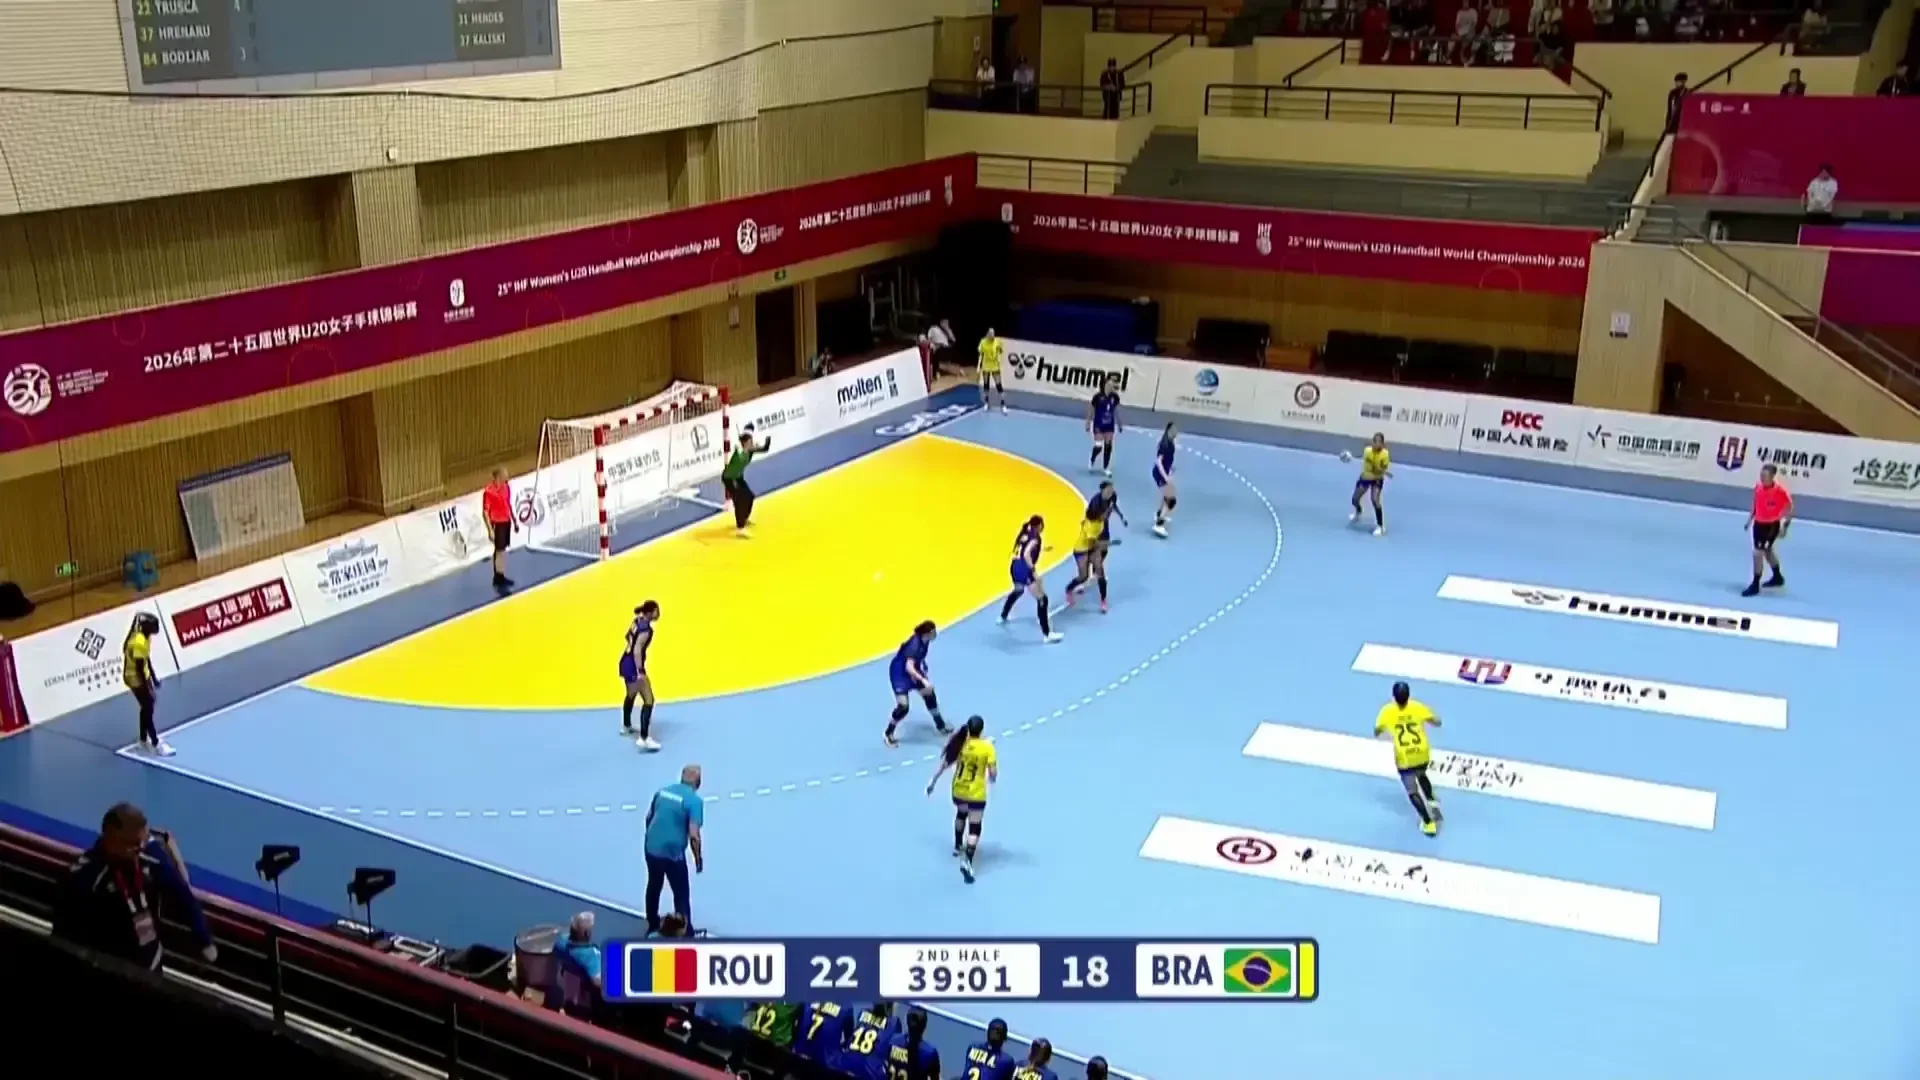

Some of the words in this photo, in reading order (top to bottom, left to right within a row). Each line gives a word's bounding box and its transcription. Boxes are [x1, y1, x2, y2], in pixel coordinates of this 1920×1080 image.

[530, 270, 569, 289] Women's
[570, 265, 587, 280] U20
[588, 259, 624, 277] Handball
[625, 252, 649, 269] World
[649, 243, 702, 265] Championship
[703, 237, 720, 252] 2026
[1323, 239, 1368, 253] Women's
[1370, 242, 1391, 254] U20
[1393, 243, 1440, 258] Handball
[1442, 247, 1474, 261] World
[1477, 250, 1555, 267] Championship
[1558, 255, 1585, 268] 2026
[837, 374, 882, 405] molten
[1501, 409, 1544, 431] PICC
[1471, 427, 1569, 452] 中国人民保险
[1617, 434, 1700, 456] 中国体育彩票
[1852, 457, 1920, 483] 怡然
[181, 623, 211, 643] MIN
[214, 612, 243, 630] YAO
[1569, 596, 1751, 631] hummel
[1395, 722, 1421, 746] 25
[752, 1005, 776, 1036] 12
[807, 1013, 823, 1040] 7
[849, 1026, 878, 1054] 18
